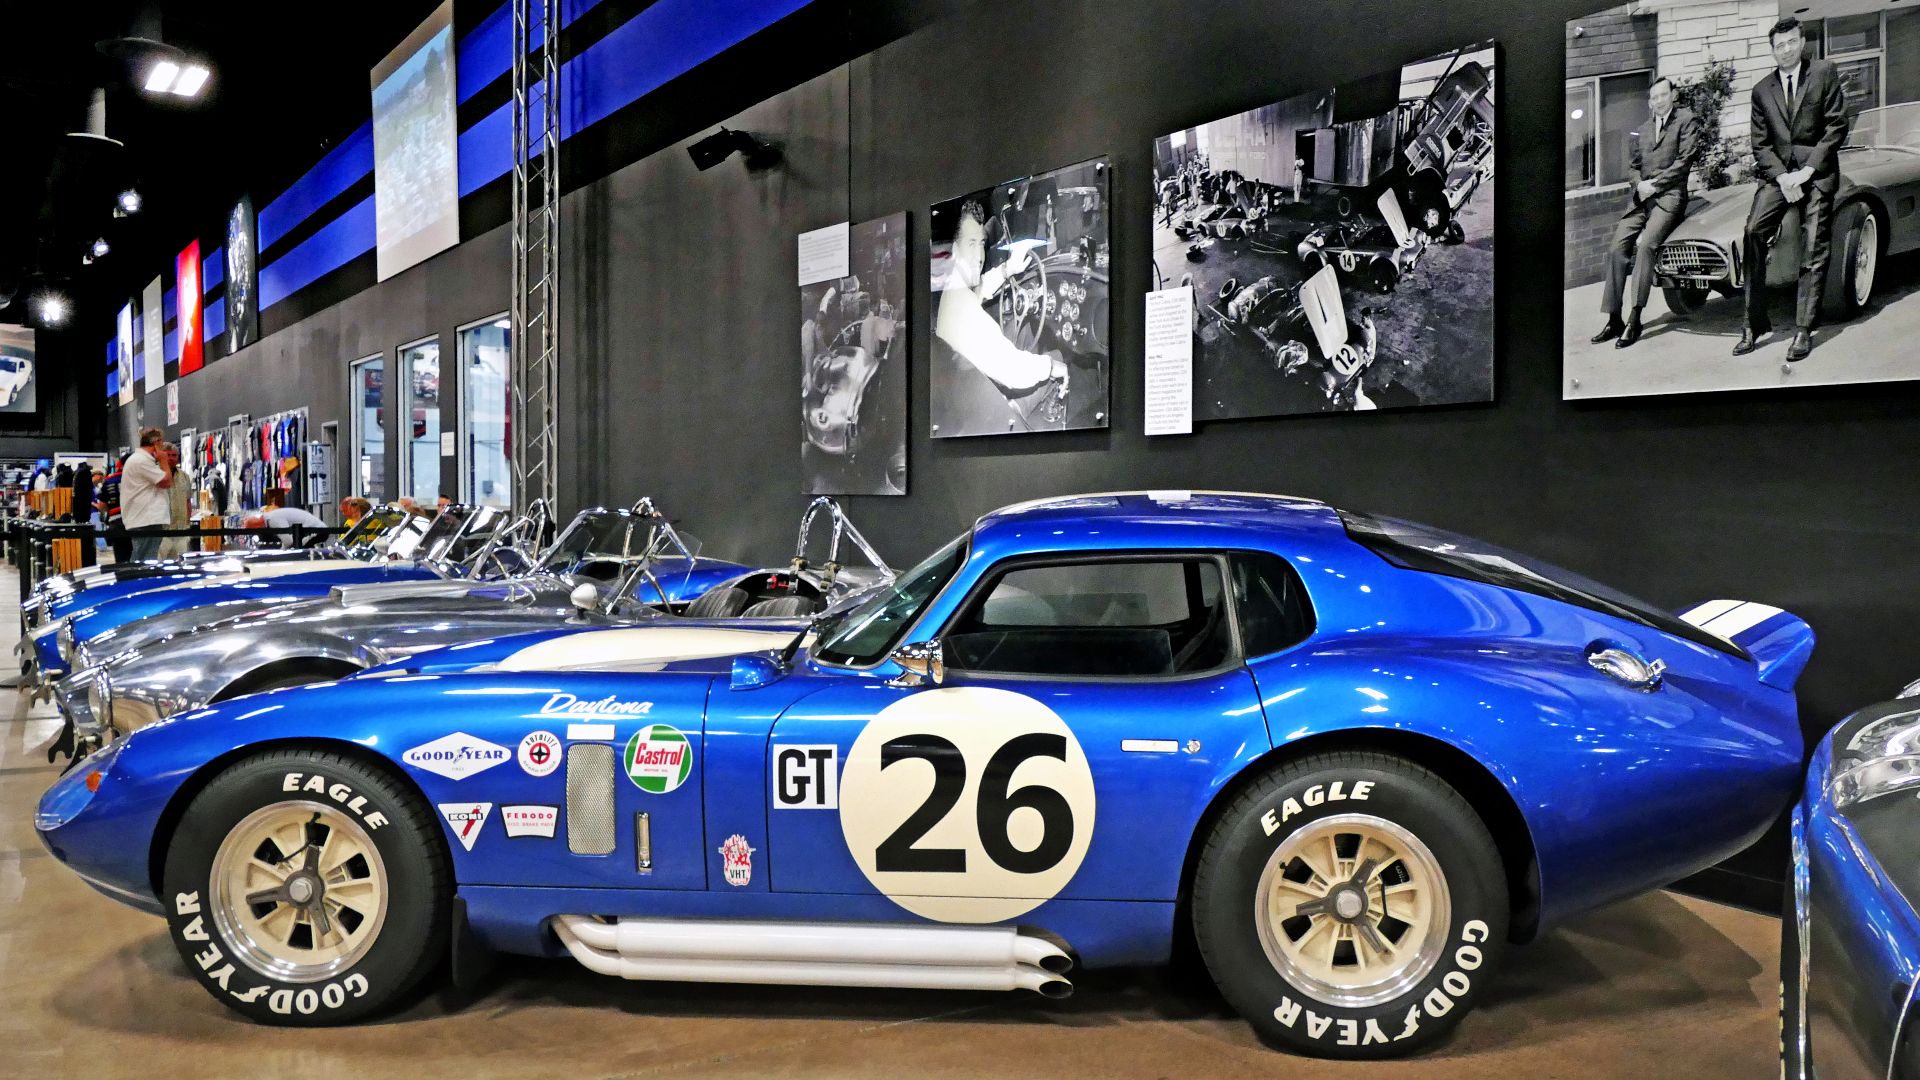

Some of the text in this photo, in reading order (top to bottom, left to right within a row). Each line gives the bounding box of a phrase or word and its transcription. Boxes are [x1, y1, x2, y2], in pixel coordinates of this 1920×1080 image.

[1342, 253, 1353, 269] 14
[1335, 347, 1357, 371] 12
[540, 693, 654, 722] Daytona
[525, 734, 558, 747] AUTOLITE
[635, 742, 684, 766] Castrol
[778, 748, 833, 805] GT
[282, 772, 389, 831] EAGLE
[875, 732, 1074, 874] 26
[1260, 780, 1375, 837] EAGLE
[449, 813, 483, 821] KONI
[730, 869, 746, 879] VHT
